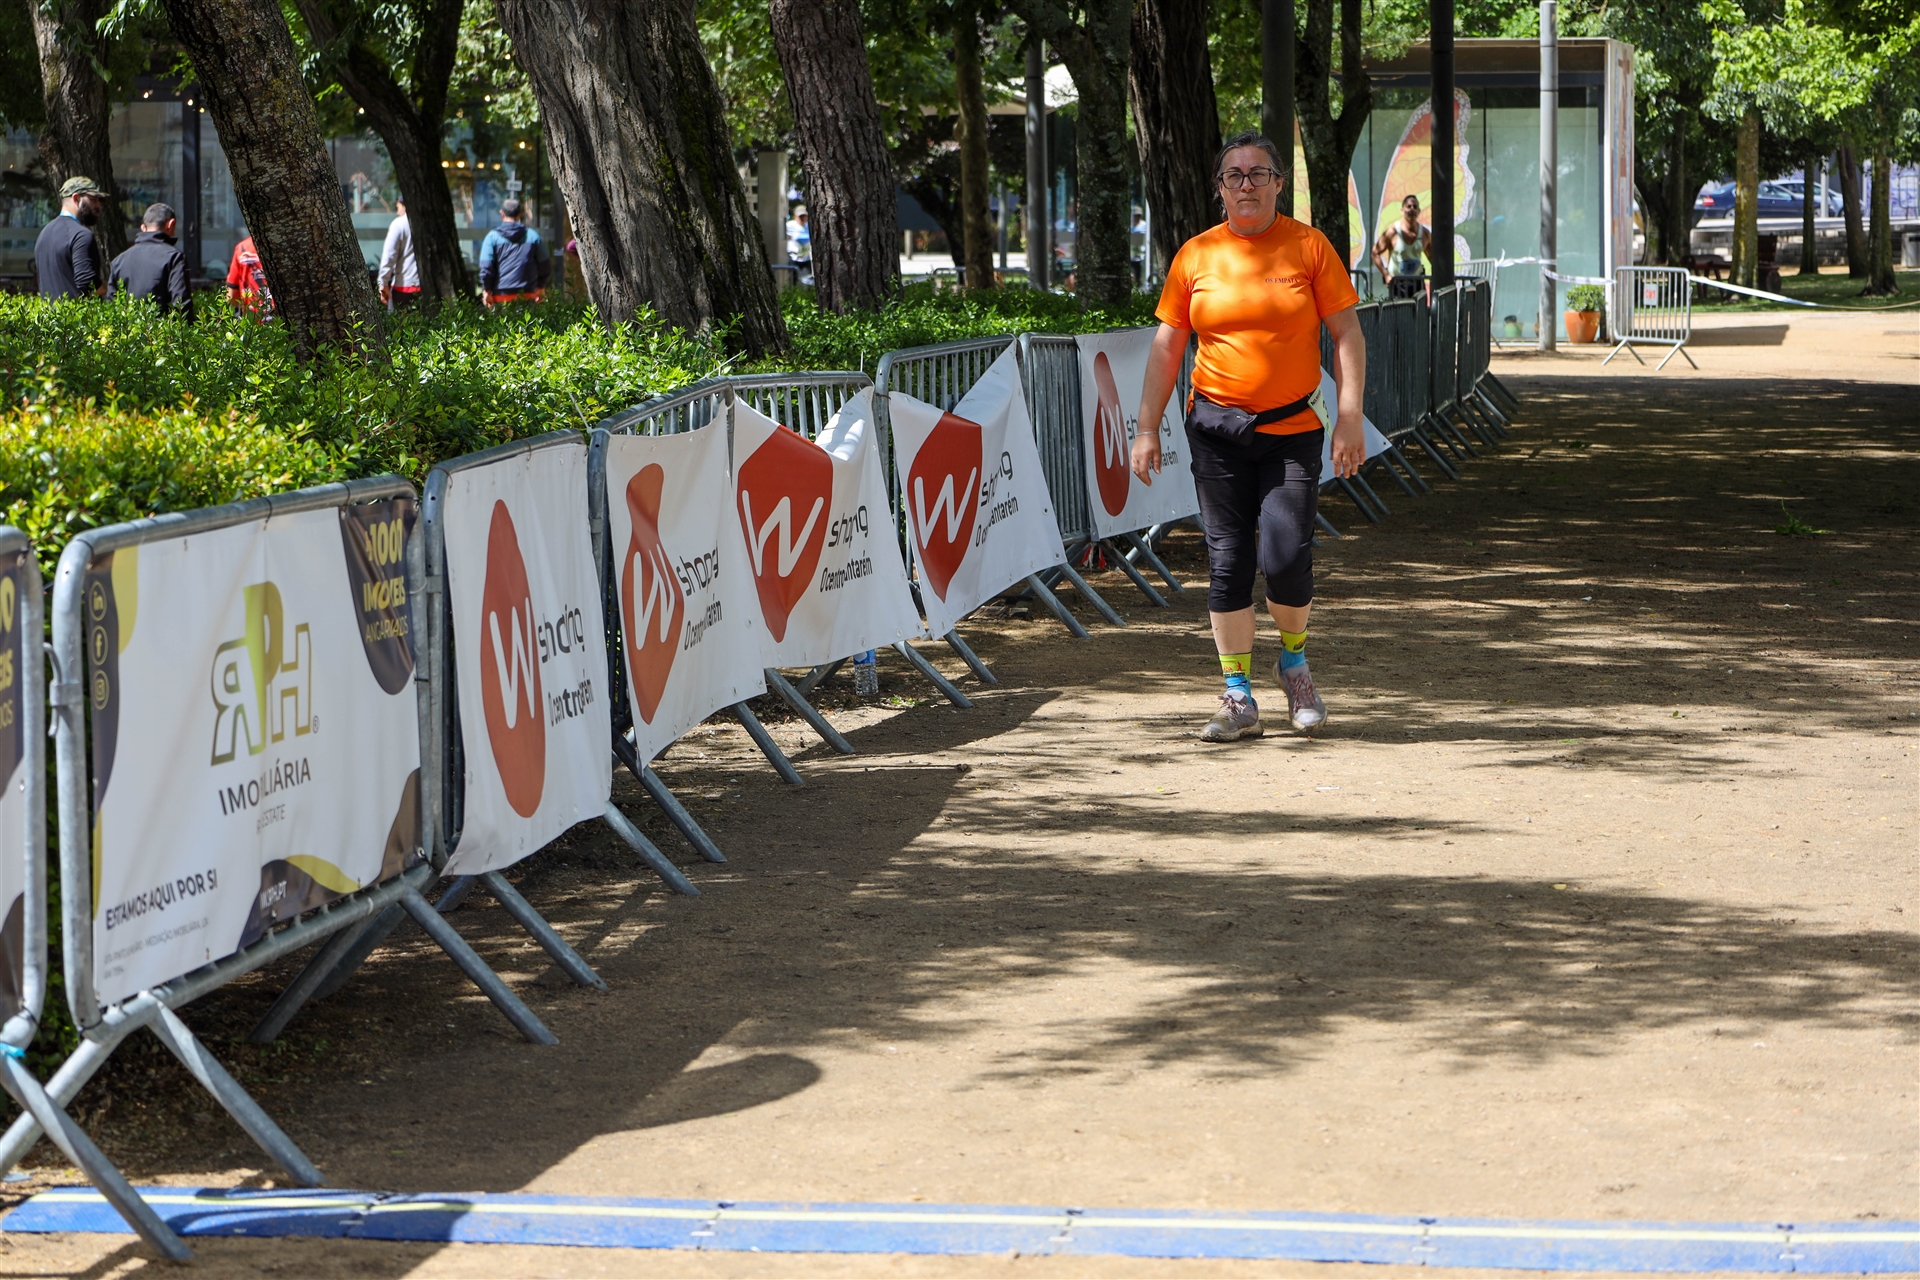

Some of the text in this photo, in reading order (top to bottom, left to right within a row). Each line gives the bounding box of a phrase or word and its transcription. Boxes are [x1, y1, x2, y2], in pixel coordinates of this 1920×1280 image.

[106, 893, 148, 930] ESTAMOS
[149, 887, 176, 912] AQUI
[176, 874, 205, 899] POR
